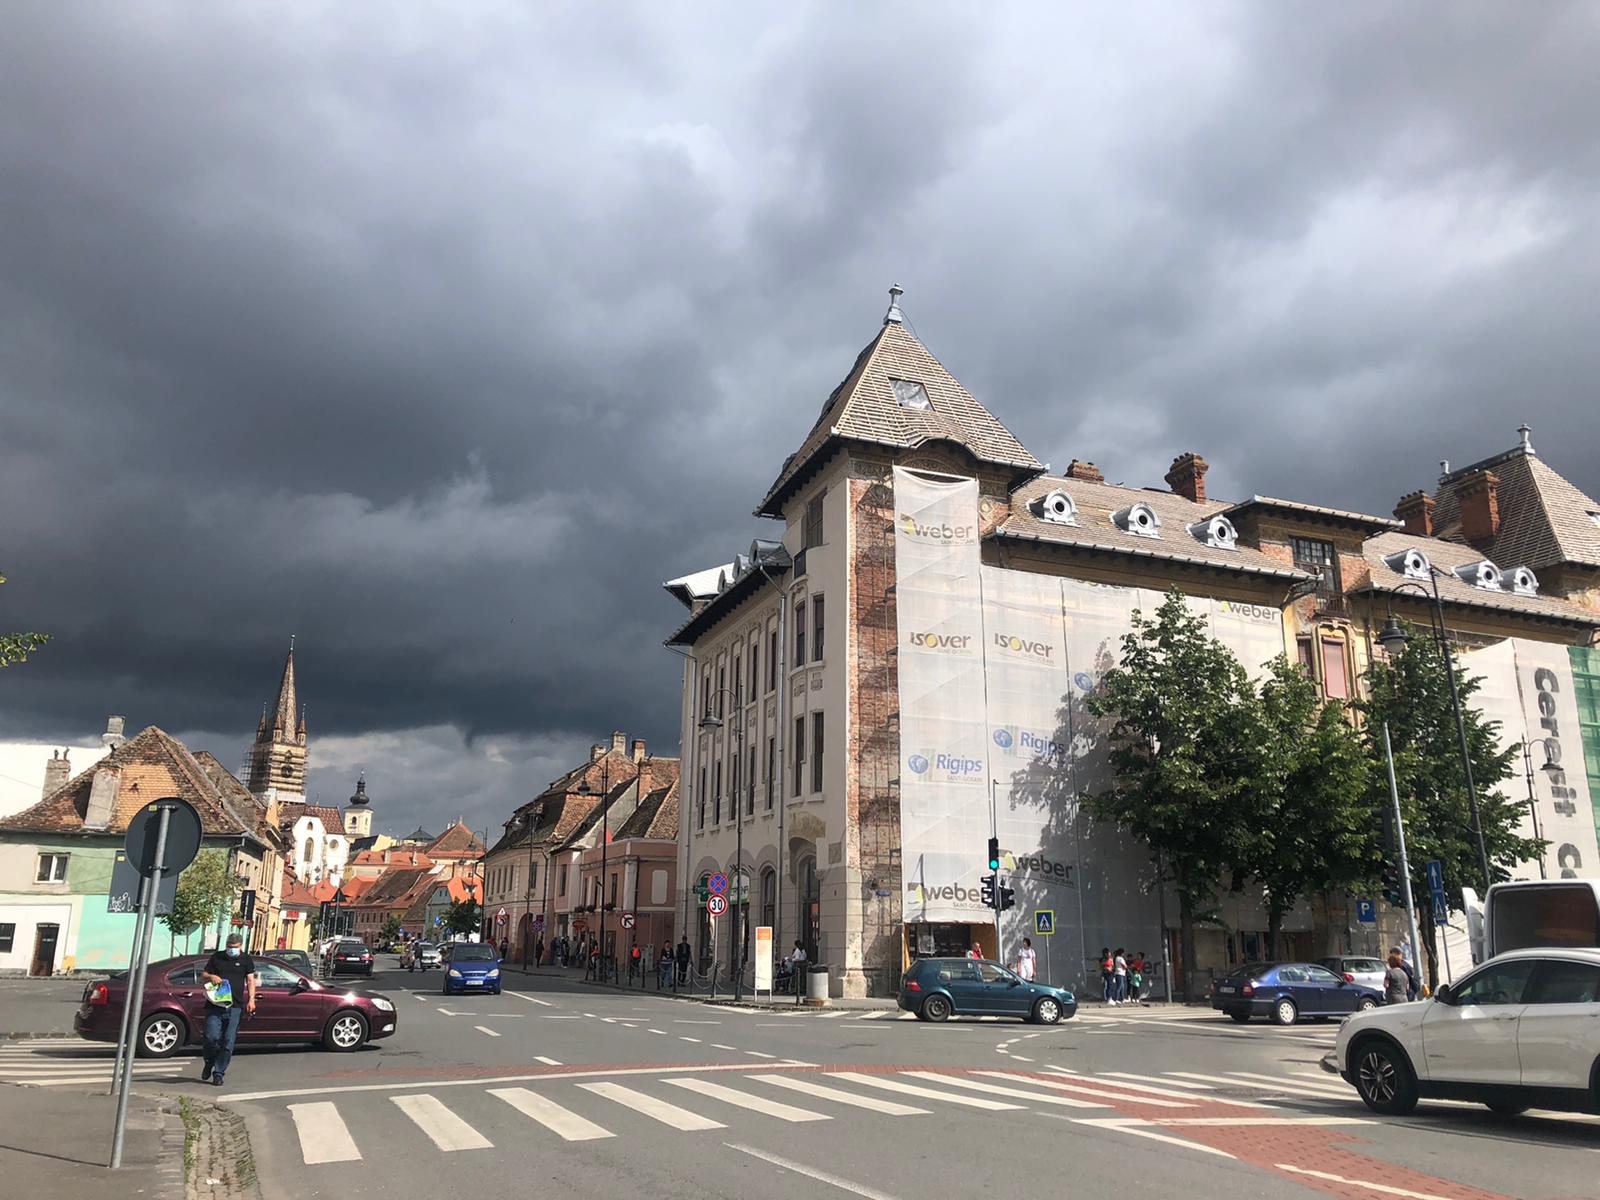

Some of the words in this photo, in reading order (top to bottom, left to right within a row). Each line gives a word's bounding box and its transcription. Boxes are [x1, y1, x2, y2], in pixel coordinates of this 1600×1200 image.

[914, 523, 973, 539] weber
[1020, 731, 1065, 755] Rigips
[936, 753, 982, 775] Rigips
[1012, 854, 1073, 878] weber
[924, 881, 981, 902] webe
[711, 898, 723, 911] 30
[1360, 902, 1370, 916] P
